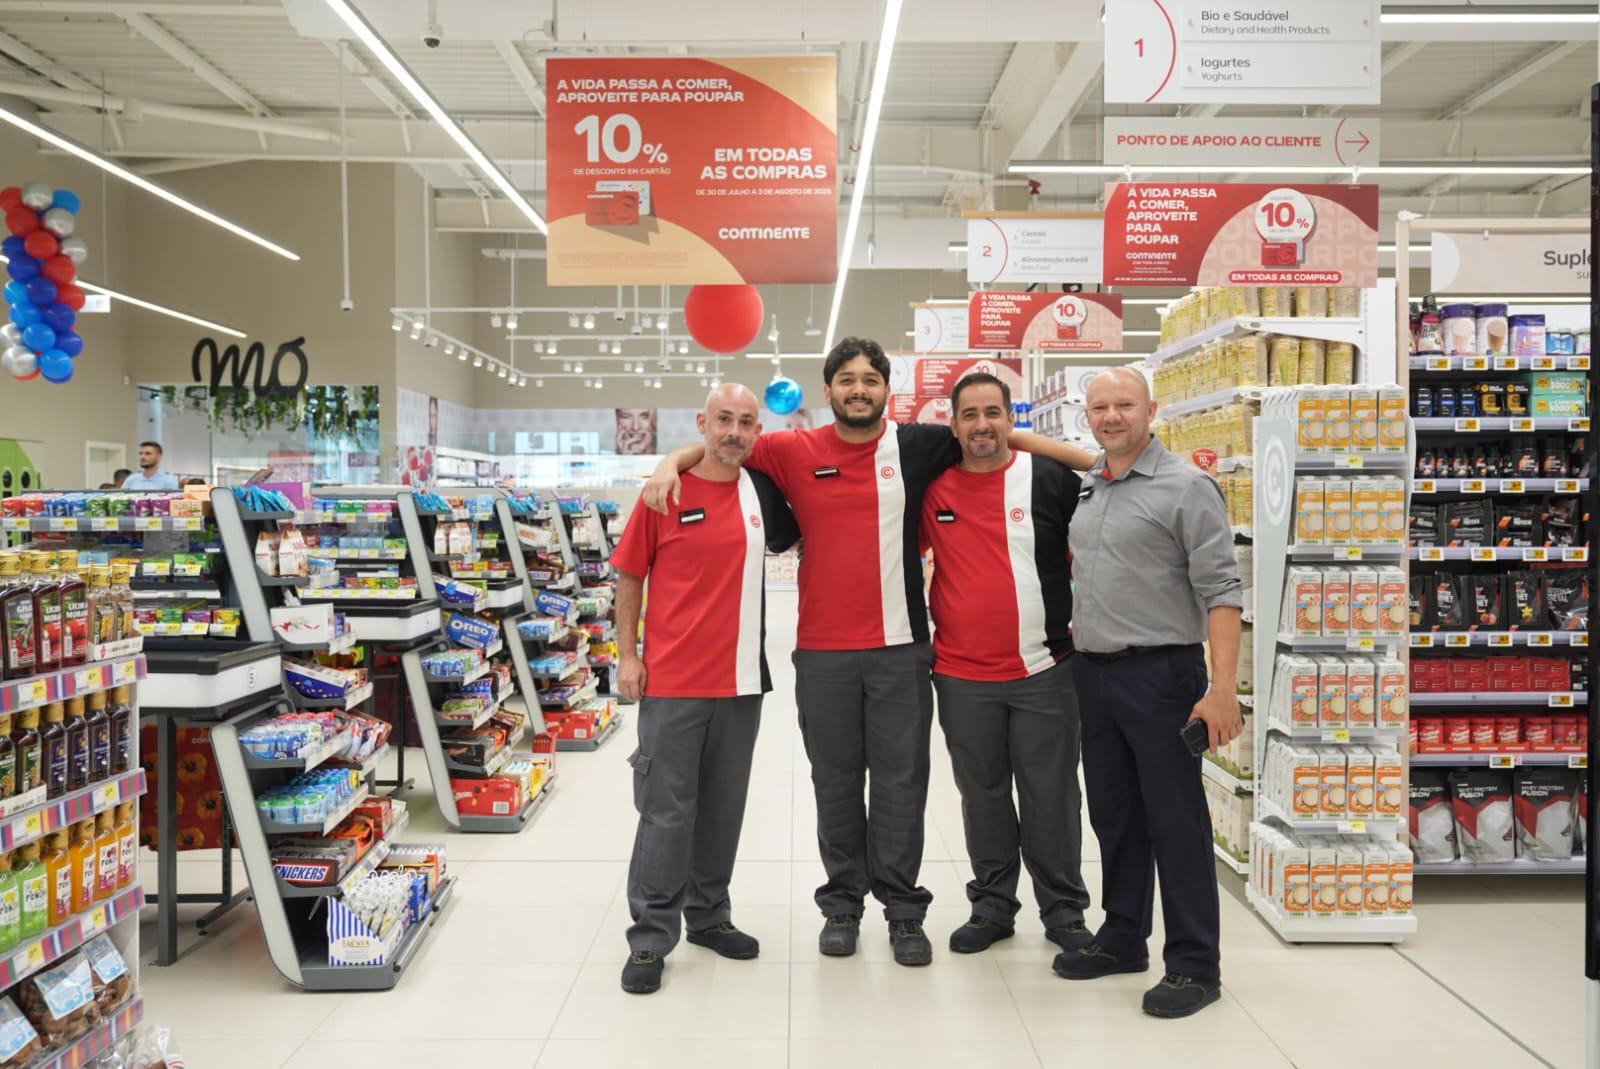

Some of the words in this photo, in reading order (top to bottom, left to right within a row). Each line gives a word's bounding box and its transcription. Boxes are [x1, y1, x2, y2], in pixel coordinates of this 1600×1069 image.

[1201, 11, 1220, 21] Bio
[1234, 10, 1289, 21] Saudável
[1201, 26, 1235, 36] Dietary
[1236, 26, 1255, 34] and
[1257, 26, 1287, 34] Health
[1289, 26, 1330, 34] Products
[1134, 38, 1144, 58] 1
[1201, 58, 1251, 69] Iogurtes
[1201, 72, 1243, 82] Yoghurts
[557, 80, 568, 89] A
[572, 80, 606, 89] VIDA
[610, 79, 658, 89] PASSA
[662, 79, 673, 89] A
[677, 79, 732, 91] COMER,
[557, 92, 638, 103] APROVEITE
[641, 92, 681, 102] PARA
[684, 91, 745, 102] POUPAR
[574, 113, 668, 164] 10%
[1117, 135, 1167, 146] PONTO
[1170, 135, 1188, 146] DE
[1192, 135, 1236, 146] APOIO
[1240, 136, 1261, 146] AO
[1265, 136, 1321, 147] CLIENTE
[715, 148, 743, 162] EM
[747, 147, 813, 162] TODAS
[640, 167, 671, 175] CARTÃO
[701, 165, 728, 180] AS
[732, 165, 827, 180] COMPRAS
[1128, 188, 1137, 198] A
[1140, 188, 1171, 198] VIDA
[1173, 188, 1217, 198] PASSA
[1127, 200, 1137, 209] A
[1139, 200, 1188, 211] COMER,
[1127, 212, 1198, 221] APROVEITE
[1261, 202, 1309, 228] 10%
[1126, 223, 1162, 233] PARA
[1126, 235, 1179, 244] POUPAR
[983, 246, 992, 257] 2
[540, 595, 568, 607] OREO
[451, 620, 488, 636] OREO
